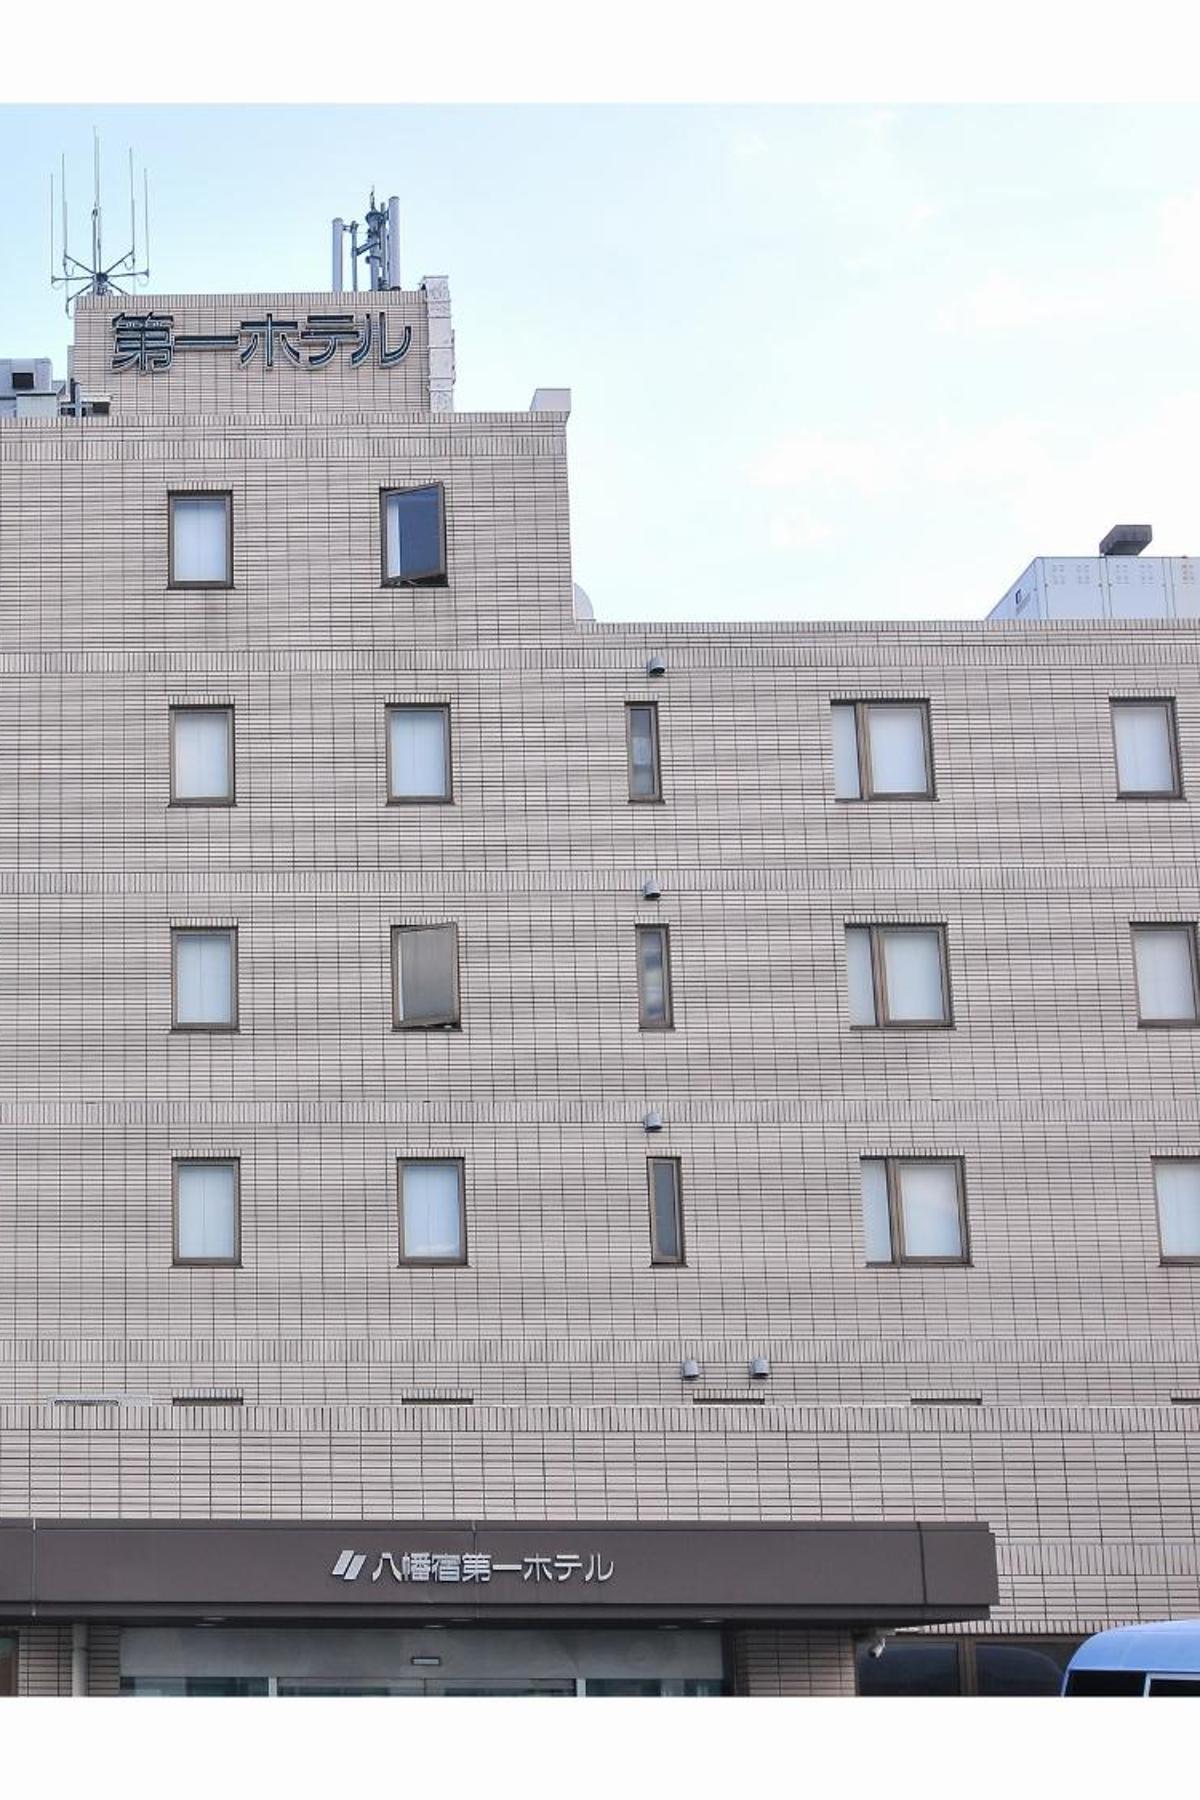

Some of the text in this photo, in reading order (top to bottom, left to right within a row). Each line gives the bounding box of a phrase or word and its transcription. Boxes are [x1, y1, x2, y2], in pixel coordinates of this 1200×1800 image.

[111, 311, 412, 373] 第一ホテル
[372, 1552, 614, 1582] 八幡宿第一ホテル
